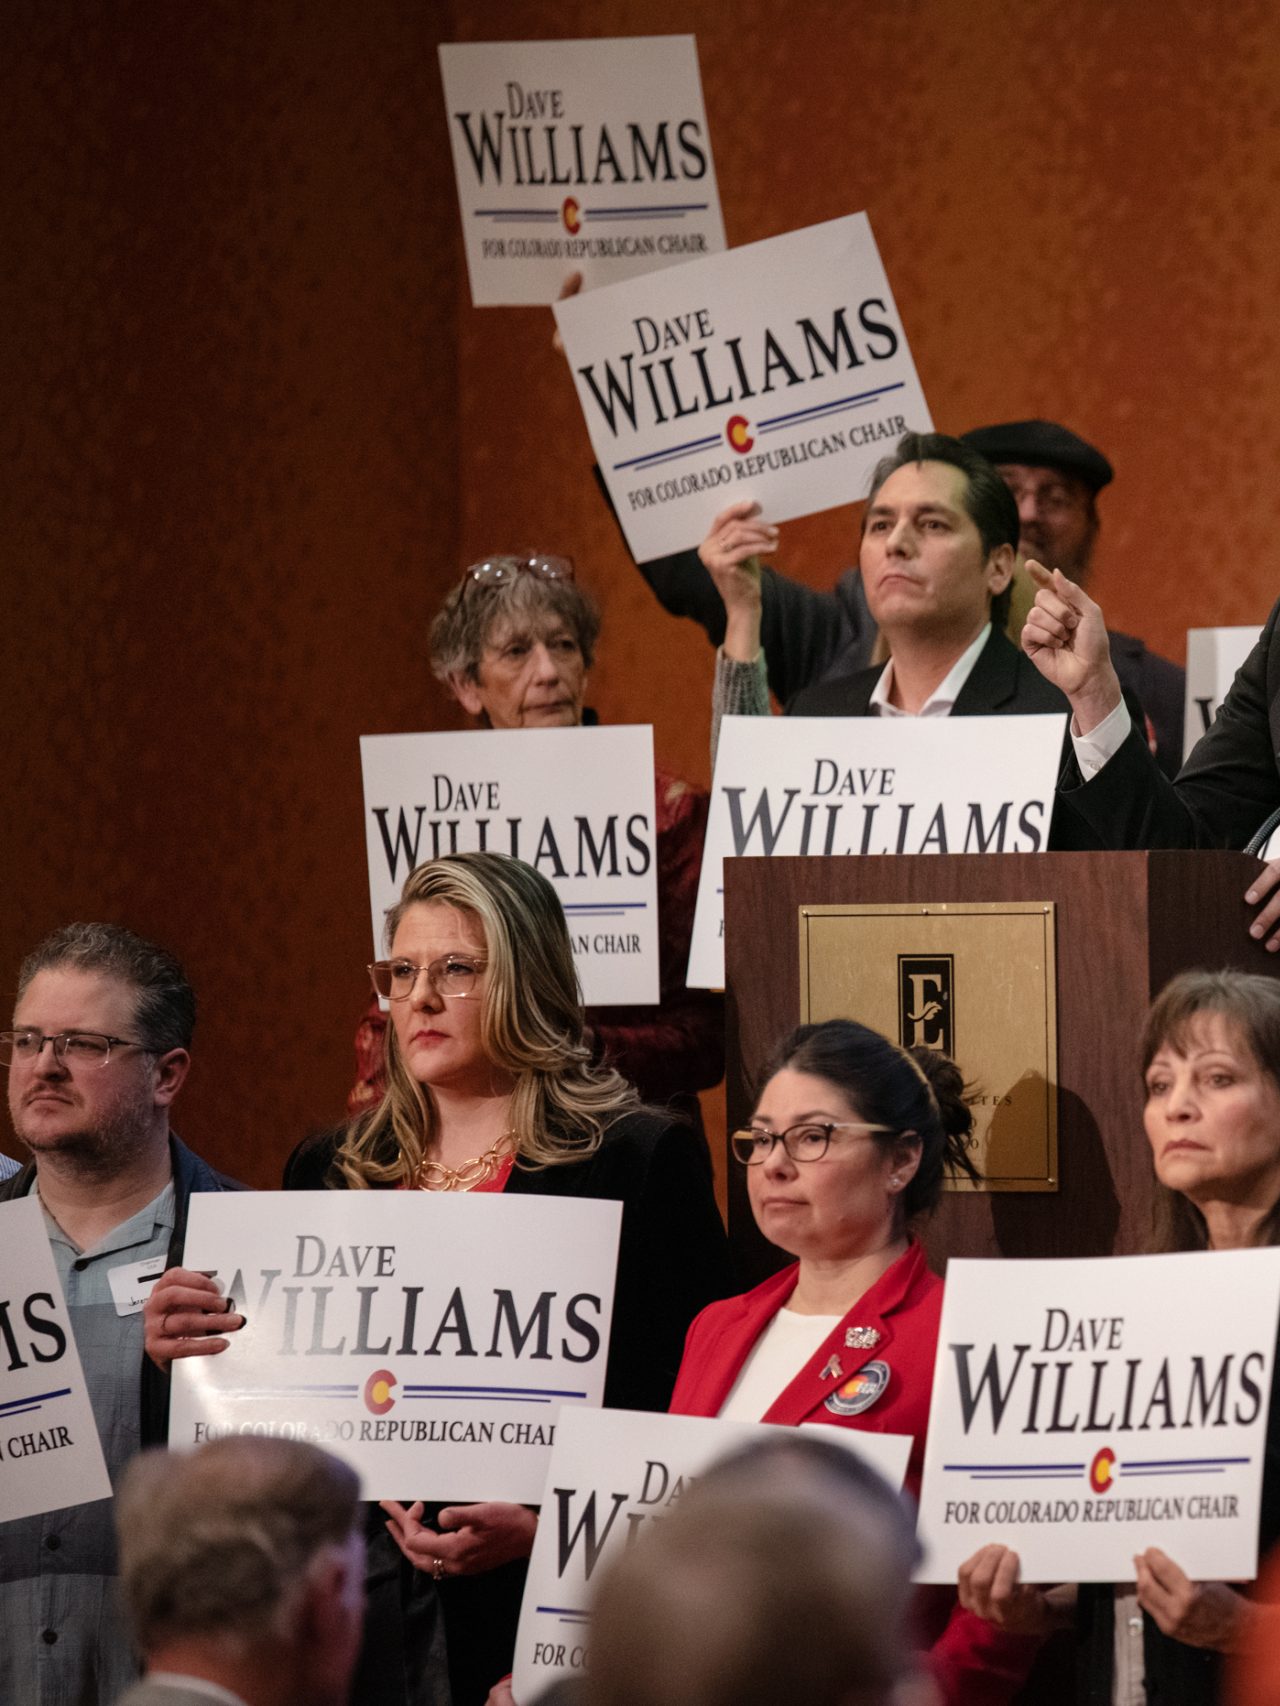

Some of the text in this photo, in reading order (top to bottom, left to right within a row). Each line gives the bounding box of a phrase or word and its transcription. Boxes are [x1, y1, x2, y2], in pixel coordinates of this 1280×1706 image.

[507, 82, 564, 119] DAVE
[454, 112, 708, 187] WILLIAMS
[633, 309, 714, 356] DAVE
[579, 299, 898, 438] WILLIAMS
[628, 415, 909, 511] FOR COLORADO REPUBLICAN CHAIR
[432, 774, 500, 811] DAVE
[812, 758, 895, 796] DAVE
[722, 786, 1045, 856] WILLIAMS
[594, 932, 641, 955] CHAIR
[293, 1235, 396, 1278] DAVE
[1042, 1308, 1123, 1352] DAVE
[949, 1342, 1265, 1435] WILLIAMS
[8, 1426, 74, 1459] CHAIR
[360, 1420, 494, 1445] REPUBLICAN
[500, 1421, 555, 1446] CHAI
[944, 1495, 1239, 1524] FOR COLORADO REPUBLICAN CHAIR
[533, 1643, 565, 1666] FOR
